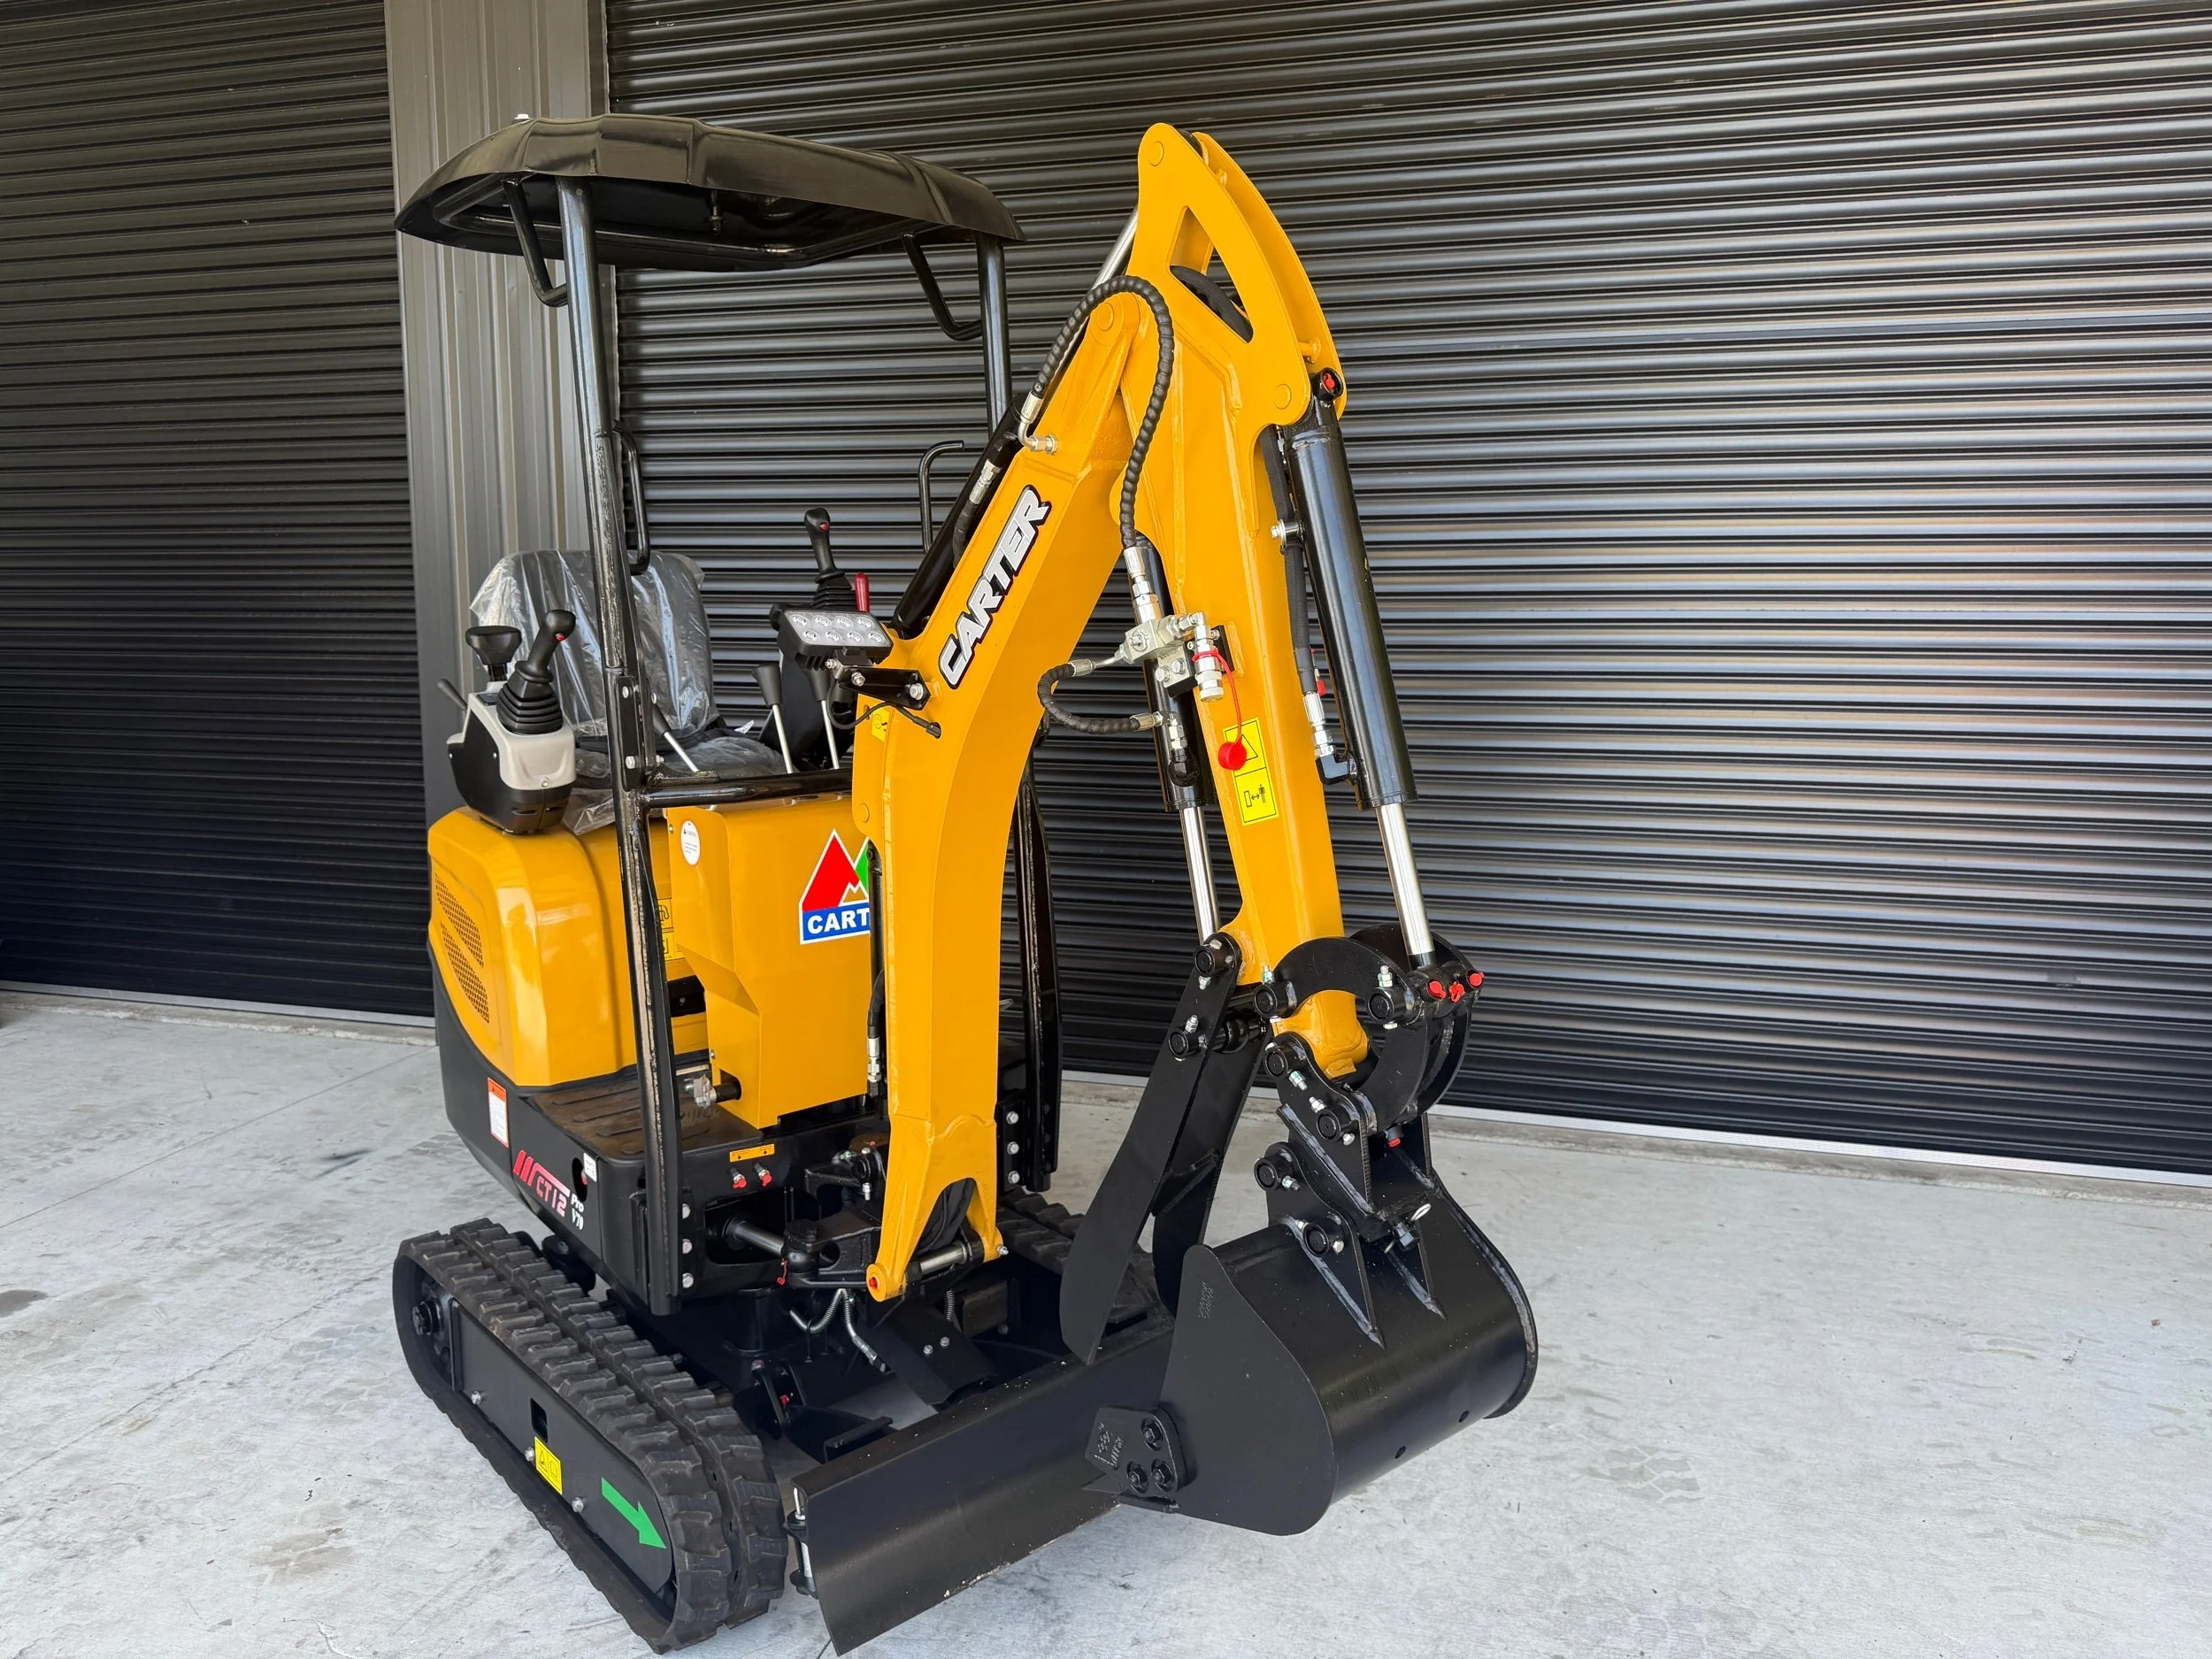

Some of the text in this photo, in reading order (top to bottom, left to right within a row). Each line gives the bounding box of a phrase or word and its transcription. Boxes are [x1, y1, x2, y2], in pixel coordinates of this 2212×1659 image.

[939, 486, 1051, 687] CARTER
[536, 1175, 567, 1217] CT12
[571, 1193, 584, 1213] Pro
